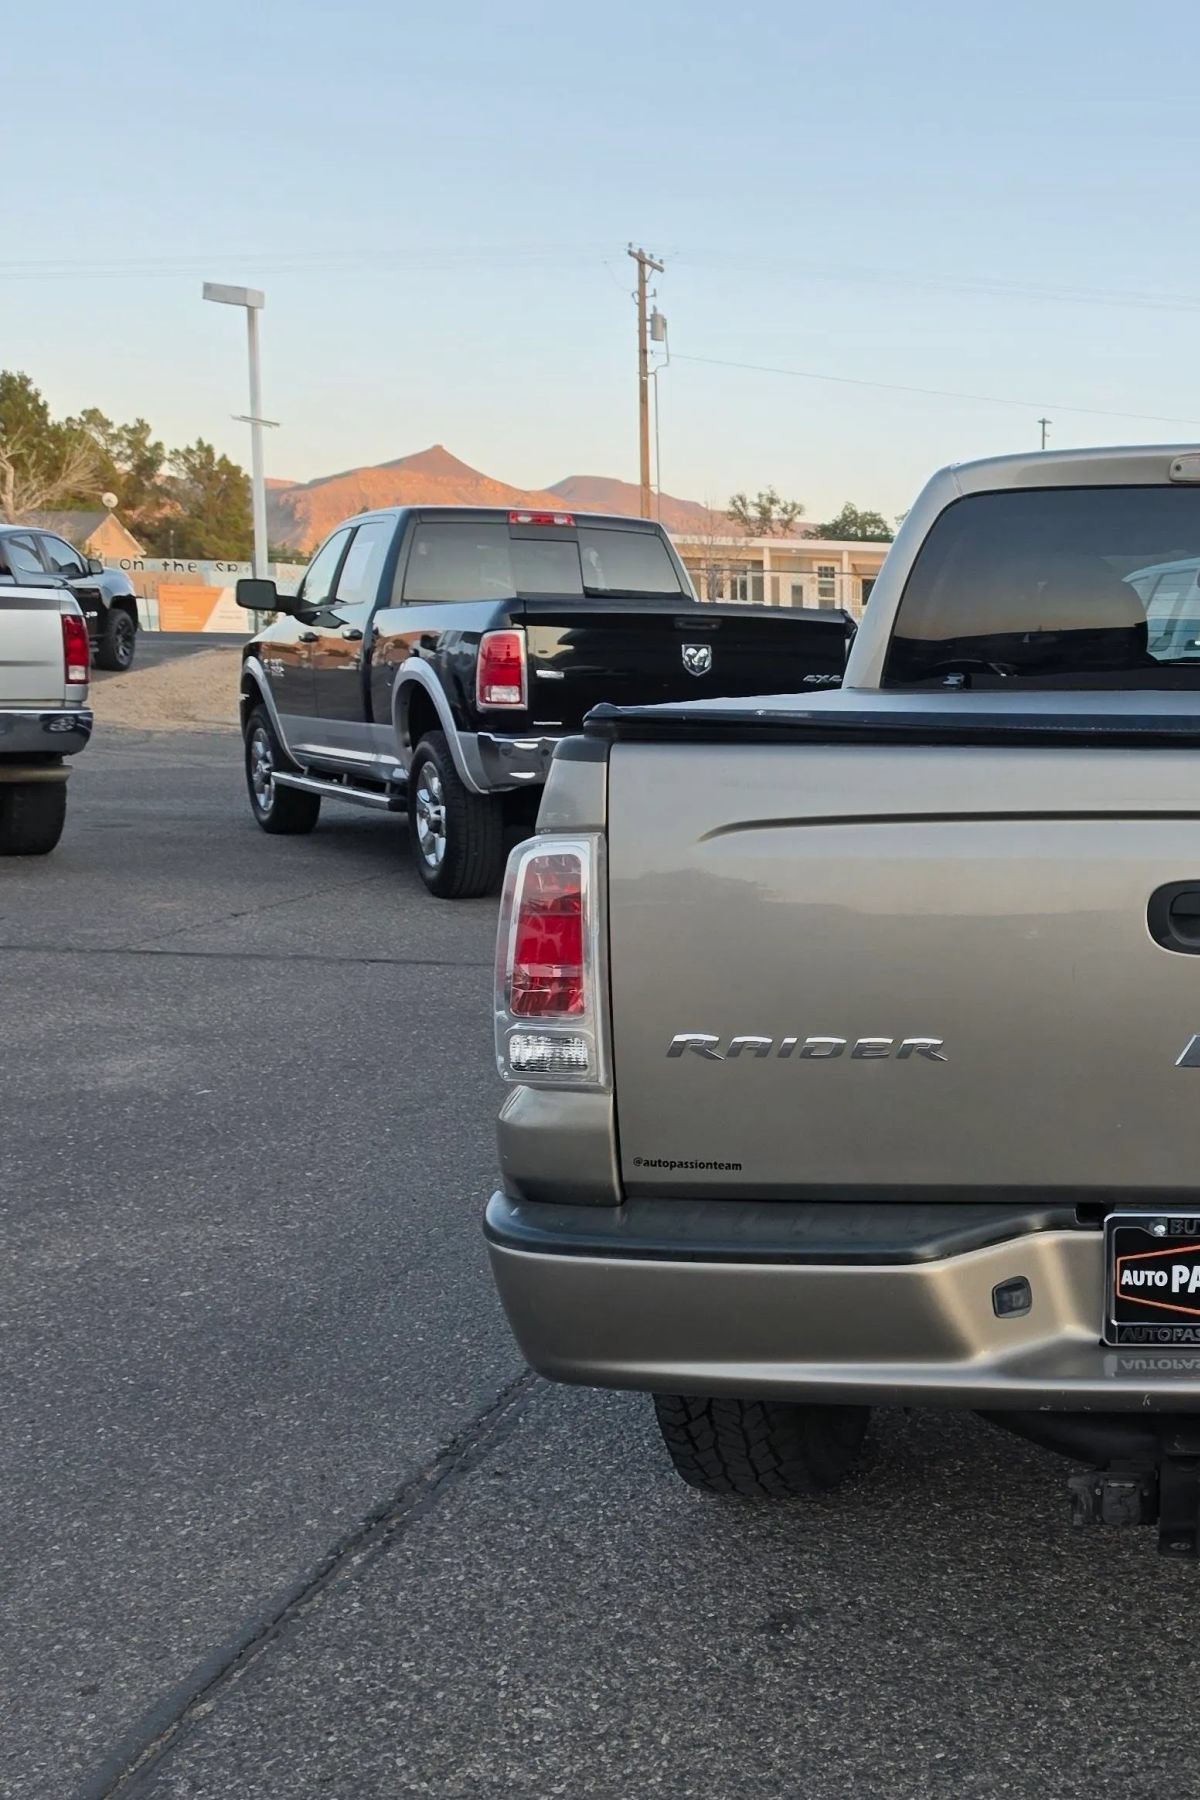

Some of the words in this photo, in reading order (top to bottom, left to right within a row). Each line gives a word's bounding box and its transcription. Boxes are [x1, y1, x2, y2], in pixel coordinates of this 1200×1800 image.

[161, 560, 198, 573] the
[666, 1033, 949, 1061] RAIDER
[632, 1156, 743, 1171] @autopassionteam
[1121, 1269, 1168, 1287] AUTO
